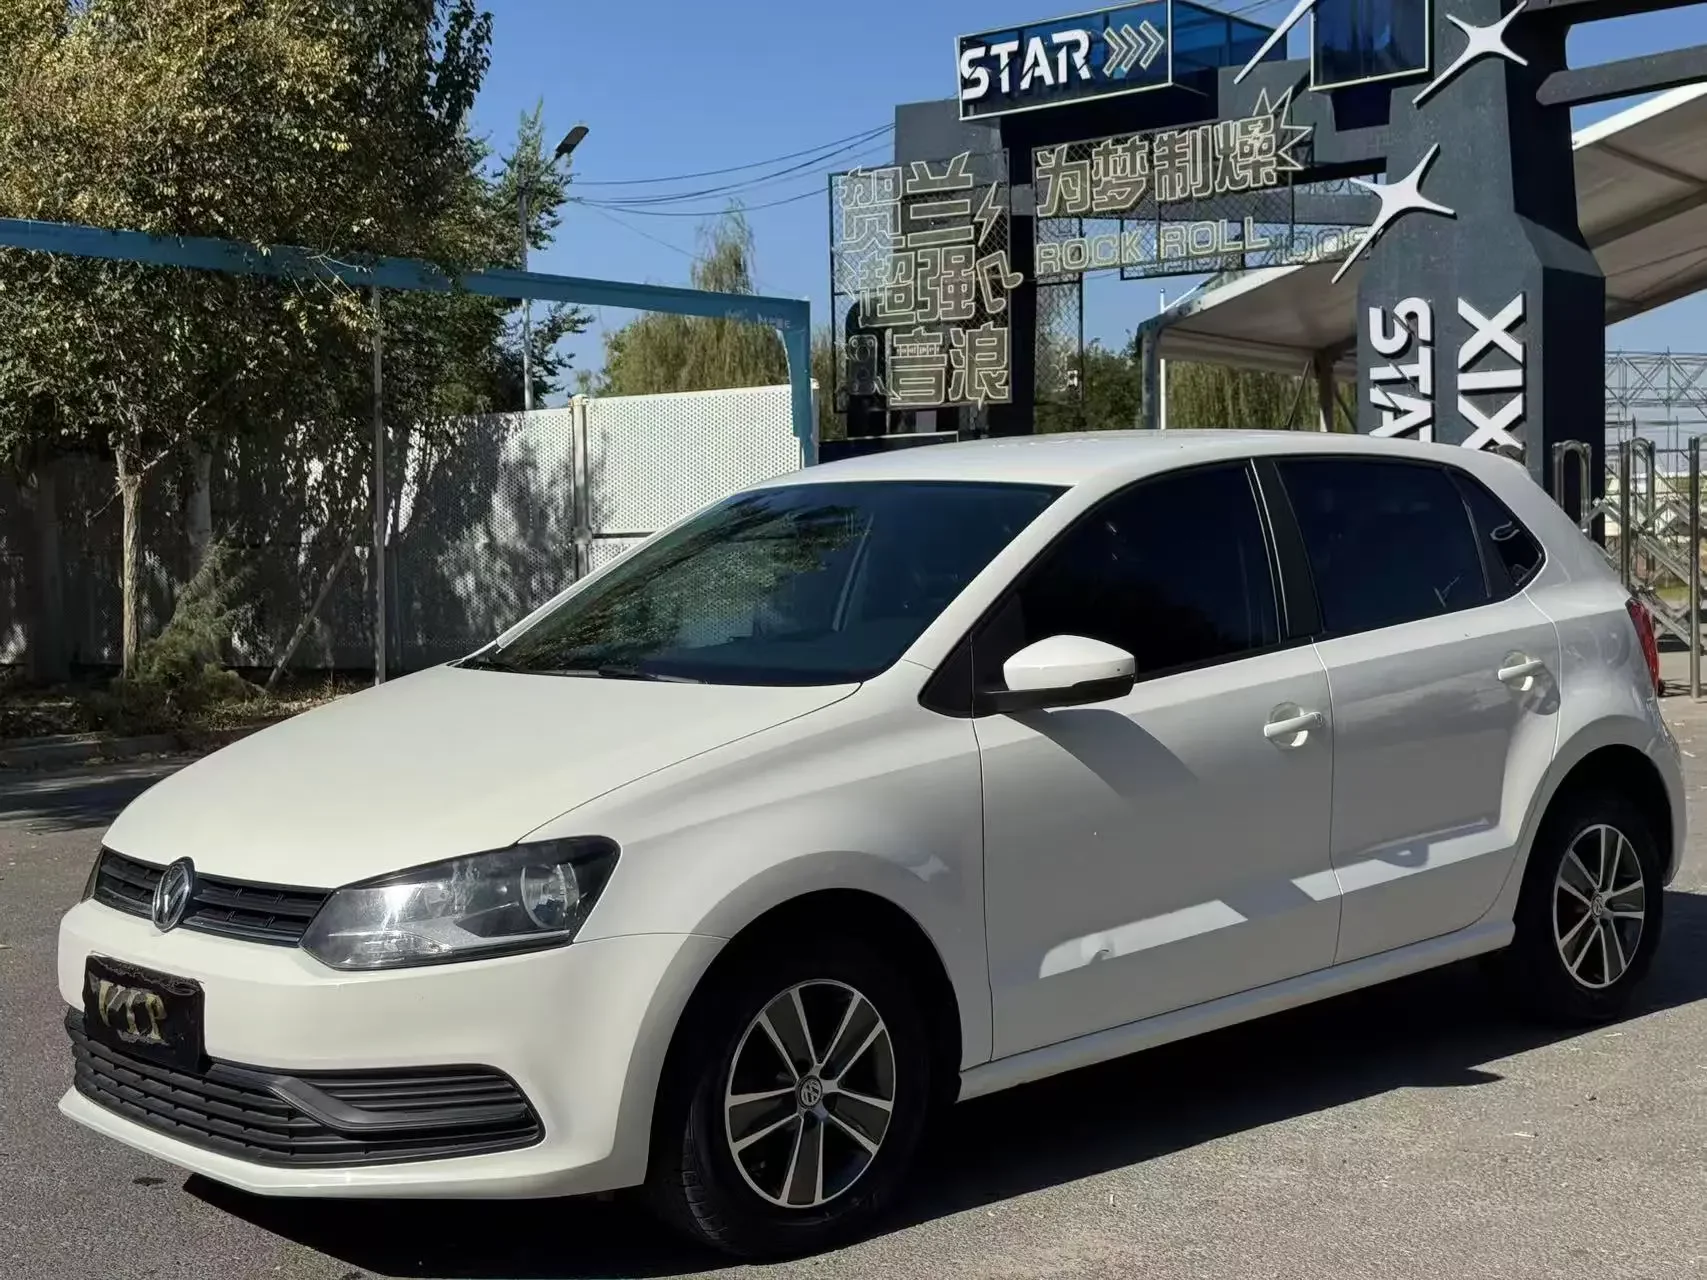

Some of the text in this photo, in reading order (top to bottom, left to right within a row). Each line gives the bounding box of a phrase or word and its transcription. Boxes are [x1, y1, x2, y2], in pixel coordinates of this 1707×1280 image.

[960, 28, 1092, 100] STAR
[838, 151, 974, 254] 贺兰
[1036, 114, 1279, 218] 为梦制燥
[859, 244, 976, 329] 超强
[1036, 229, 1145, 275] ROCK
[1159, 215, 1271, 259] ROLL
[889, 321, 1010, 408] 音浪
[1369, 297, 1433, 444] STA
